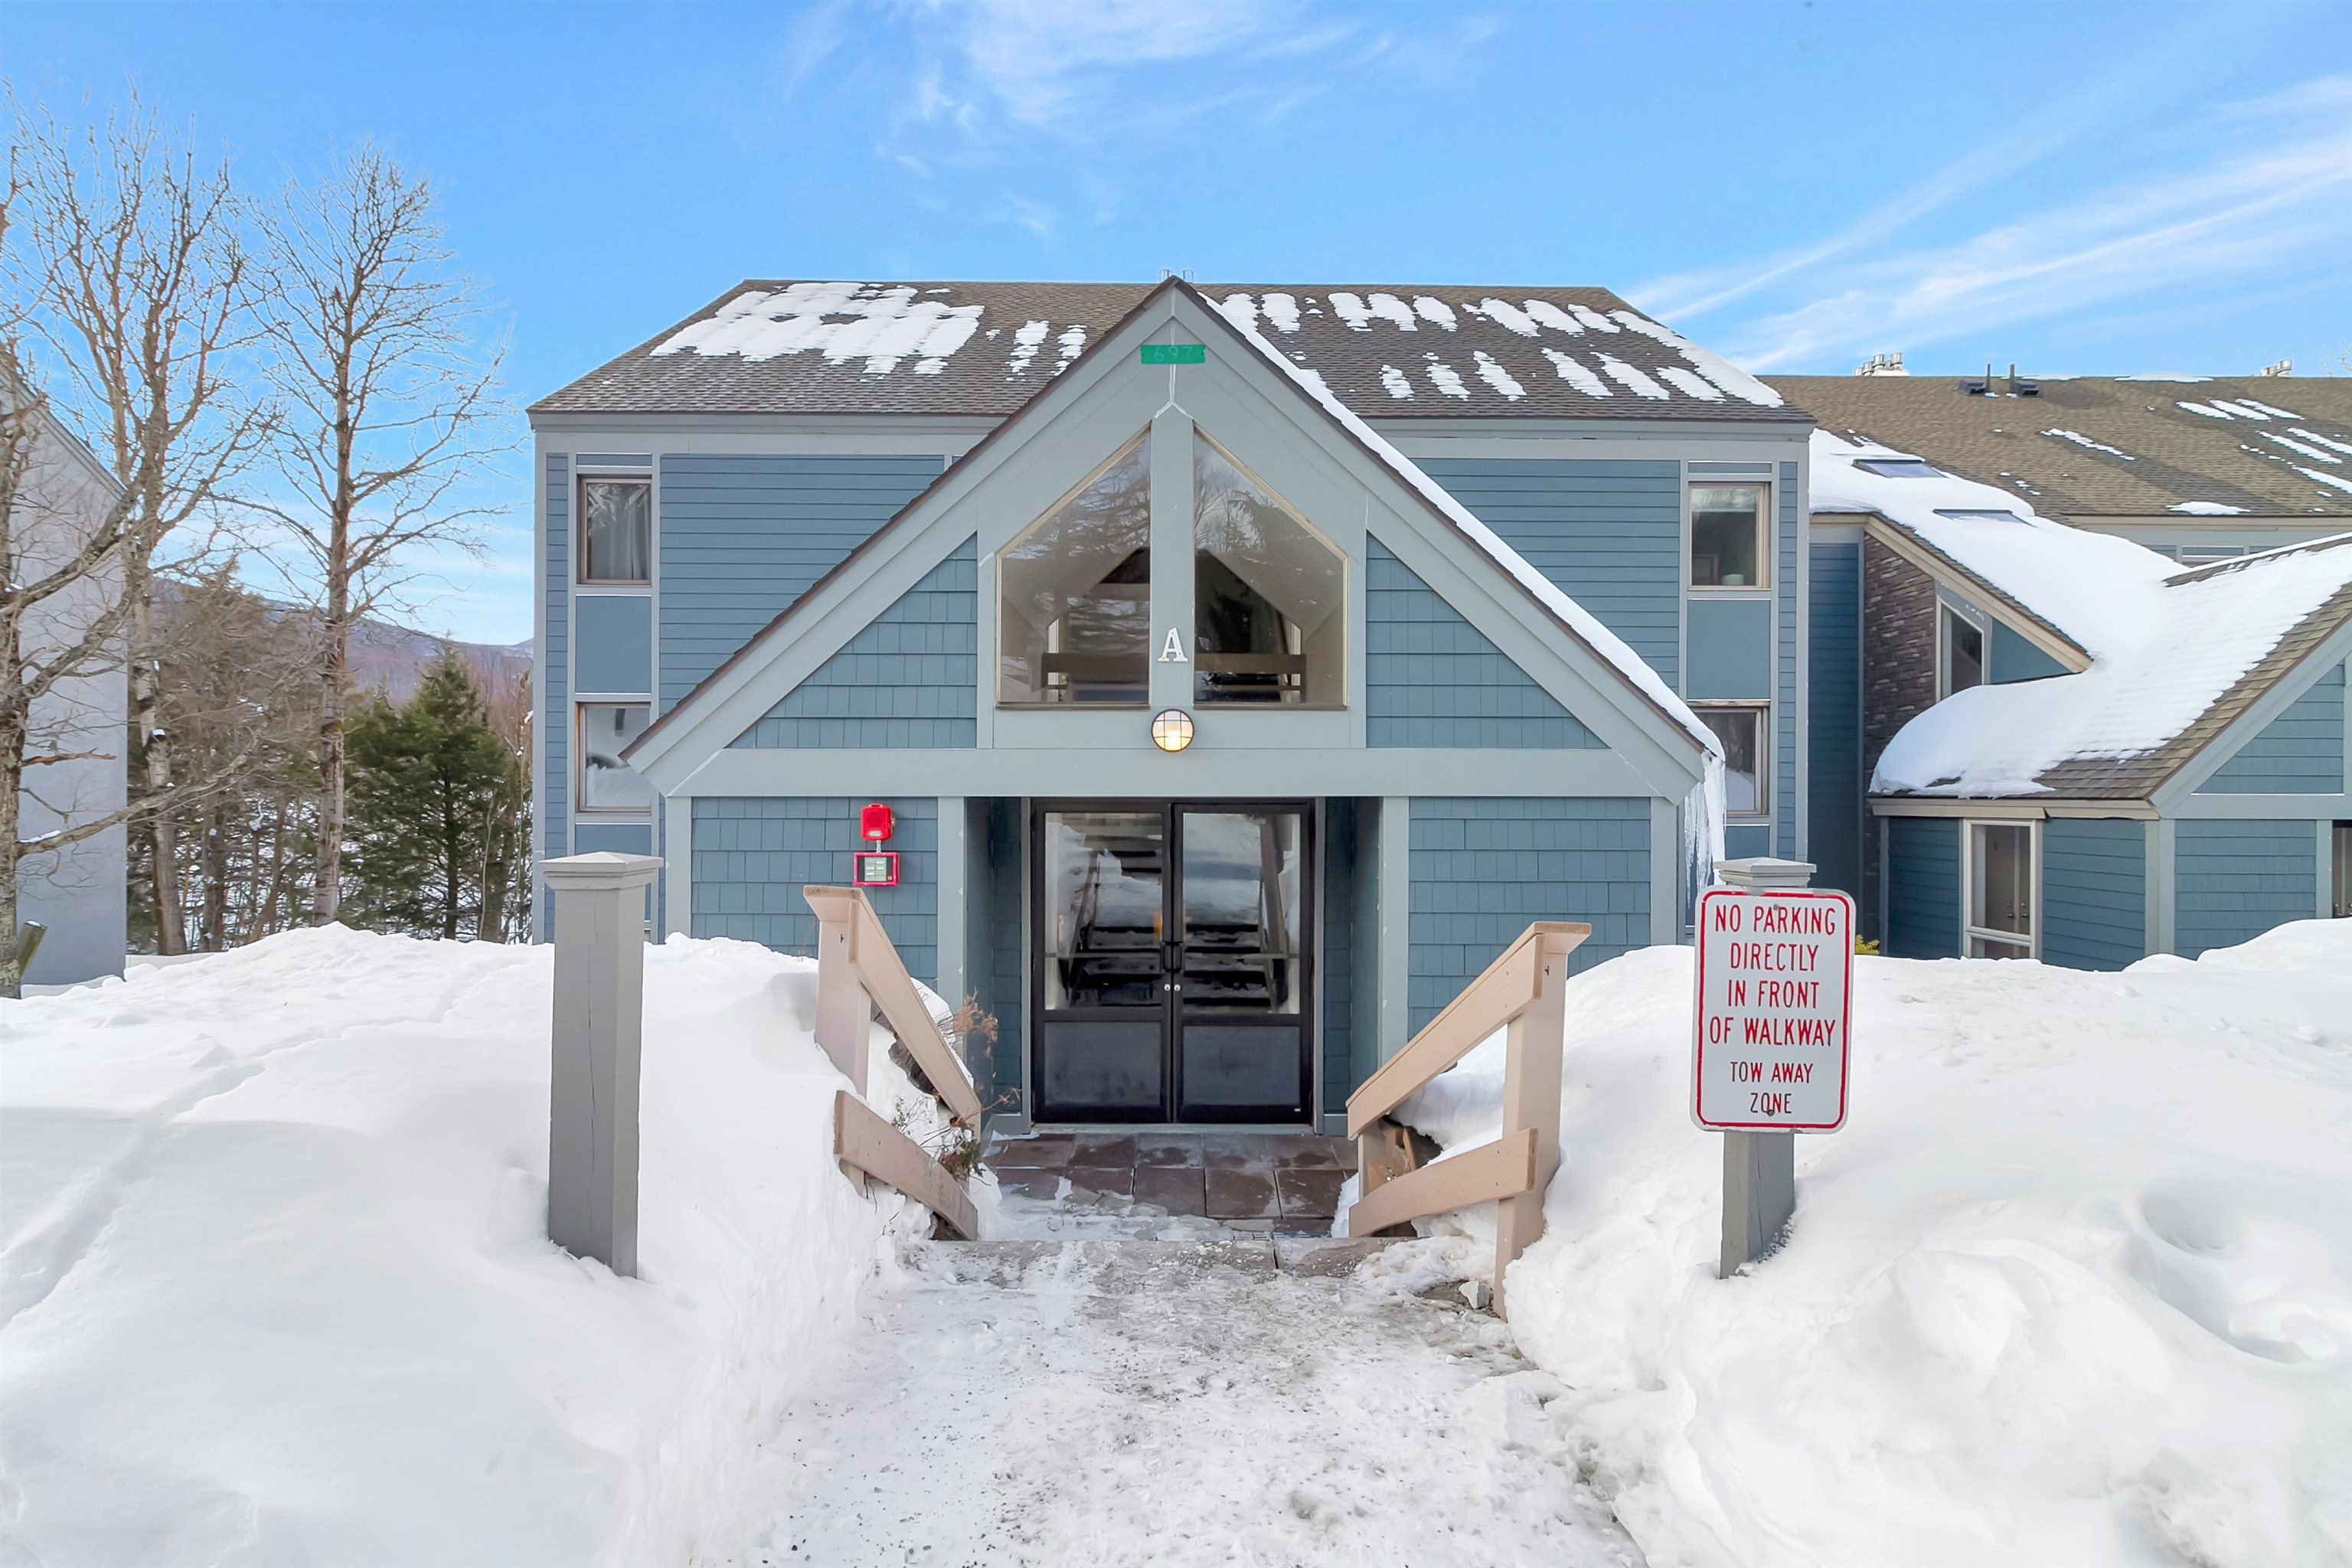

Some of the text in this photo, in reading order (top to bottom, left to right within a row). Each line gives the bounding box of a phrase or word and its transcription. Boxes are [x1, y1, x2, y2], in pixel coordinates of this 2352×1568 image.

[1154, 346, 1193, 362] 697
[1158, 627, 1188, 662] A
[1715, 904, 1836, 936] NO PARKING
[1730, 942, 1818, 972] DIRECTLY
[1728, 979, 1819, 1008] IN FRONT
[1710, 1016, 1836, 1047] OF WALKWAY
[1730, 1061, 1813, 1083] TOW AWAY
[1749, 1093, 1792, 1114] ZONE
